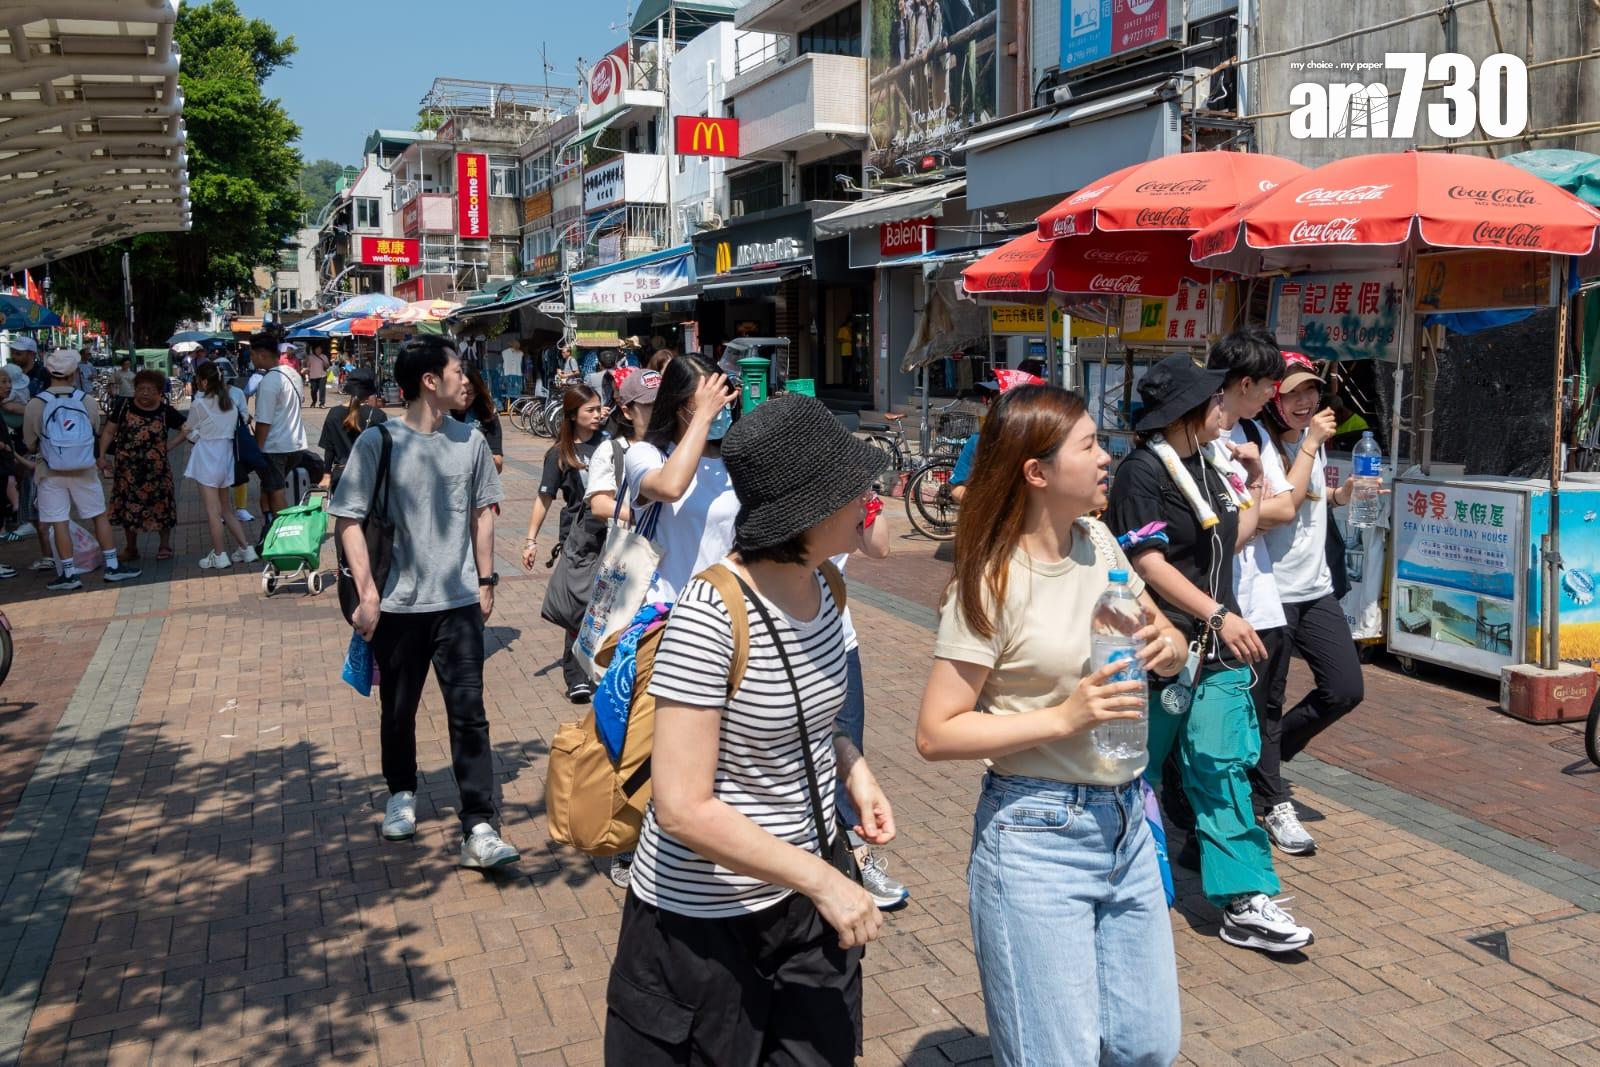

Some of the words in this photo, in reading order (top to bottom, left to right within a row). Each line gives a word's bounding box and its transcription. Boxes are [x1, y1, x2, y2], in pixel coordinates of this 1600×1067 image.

[467, 157, 477, 177] 惠康
[1136, 179, 1211, 193] Coca-Cola
[1295, 184, 1392, 204] Coca-Cola
[1448, 185, 1536, 205] Coca-Cola
[468, 178, 479, 235] wellcome
[1136, 206, 1193, 227] Coca-Cola
[1289, 217, 1361, 243] Coca-Cola
[1472, 220, 1544, 248] Coca-Cola
[376, 240, 406, 255] 惠康
[372, 254, 410, 263] wellcome
[1089, 273, 1143, 293] Coca-Cola
[1407, 489, 1449, 521] 海景
[1453, 499, 1504, 528] 度假屋
[1403, 521, 1418, 532] SEA
[1421, 523, 1442, 535] VIEW
[1444, 527, 1479, 539] HOLIDAY
[1481, 531, 1509, 544] HOUSE
